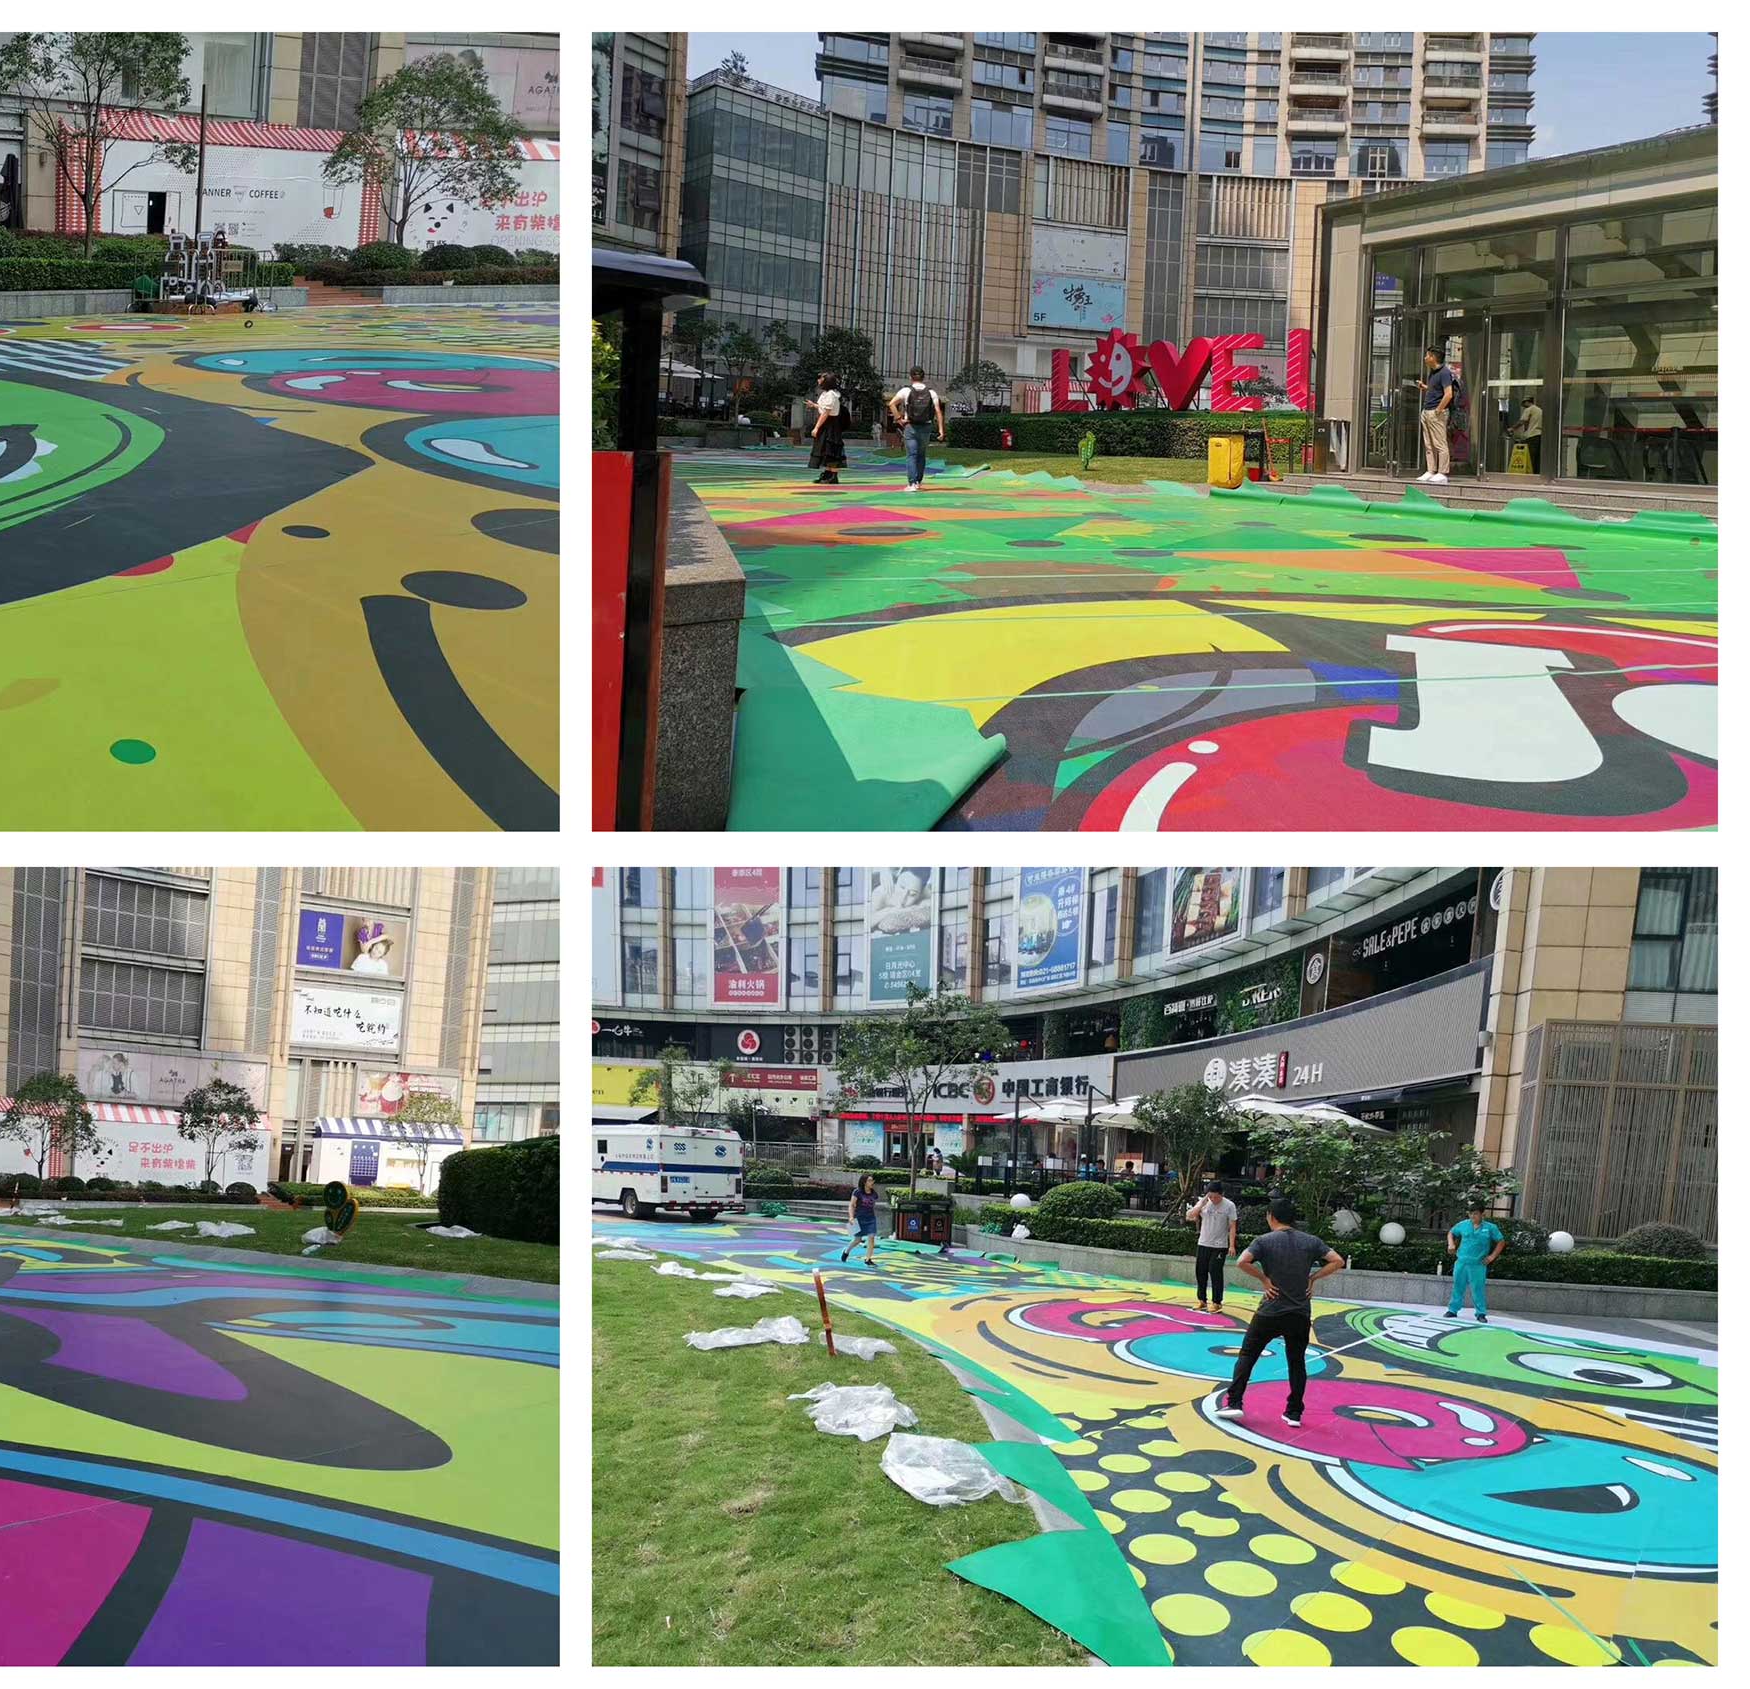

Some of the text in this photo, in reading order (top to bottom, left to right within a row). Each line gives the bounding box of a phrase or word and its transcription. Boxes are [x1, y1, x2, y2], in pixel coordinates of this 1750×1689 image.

[249, 189, 279, 199] COFFEE
[1033, 312, 1047, 321] 5F
[1293, 1062, 1323, 1086] 24H
[933, 1081, 970, 1099] ICBC
[1002, 1075, 1090, 1098] 中国工商银行
